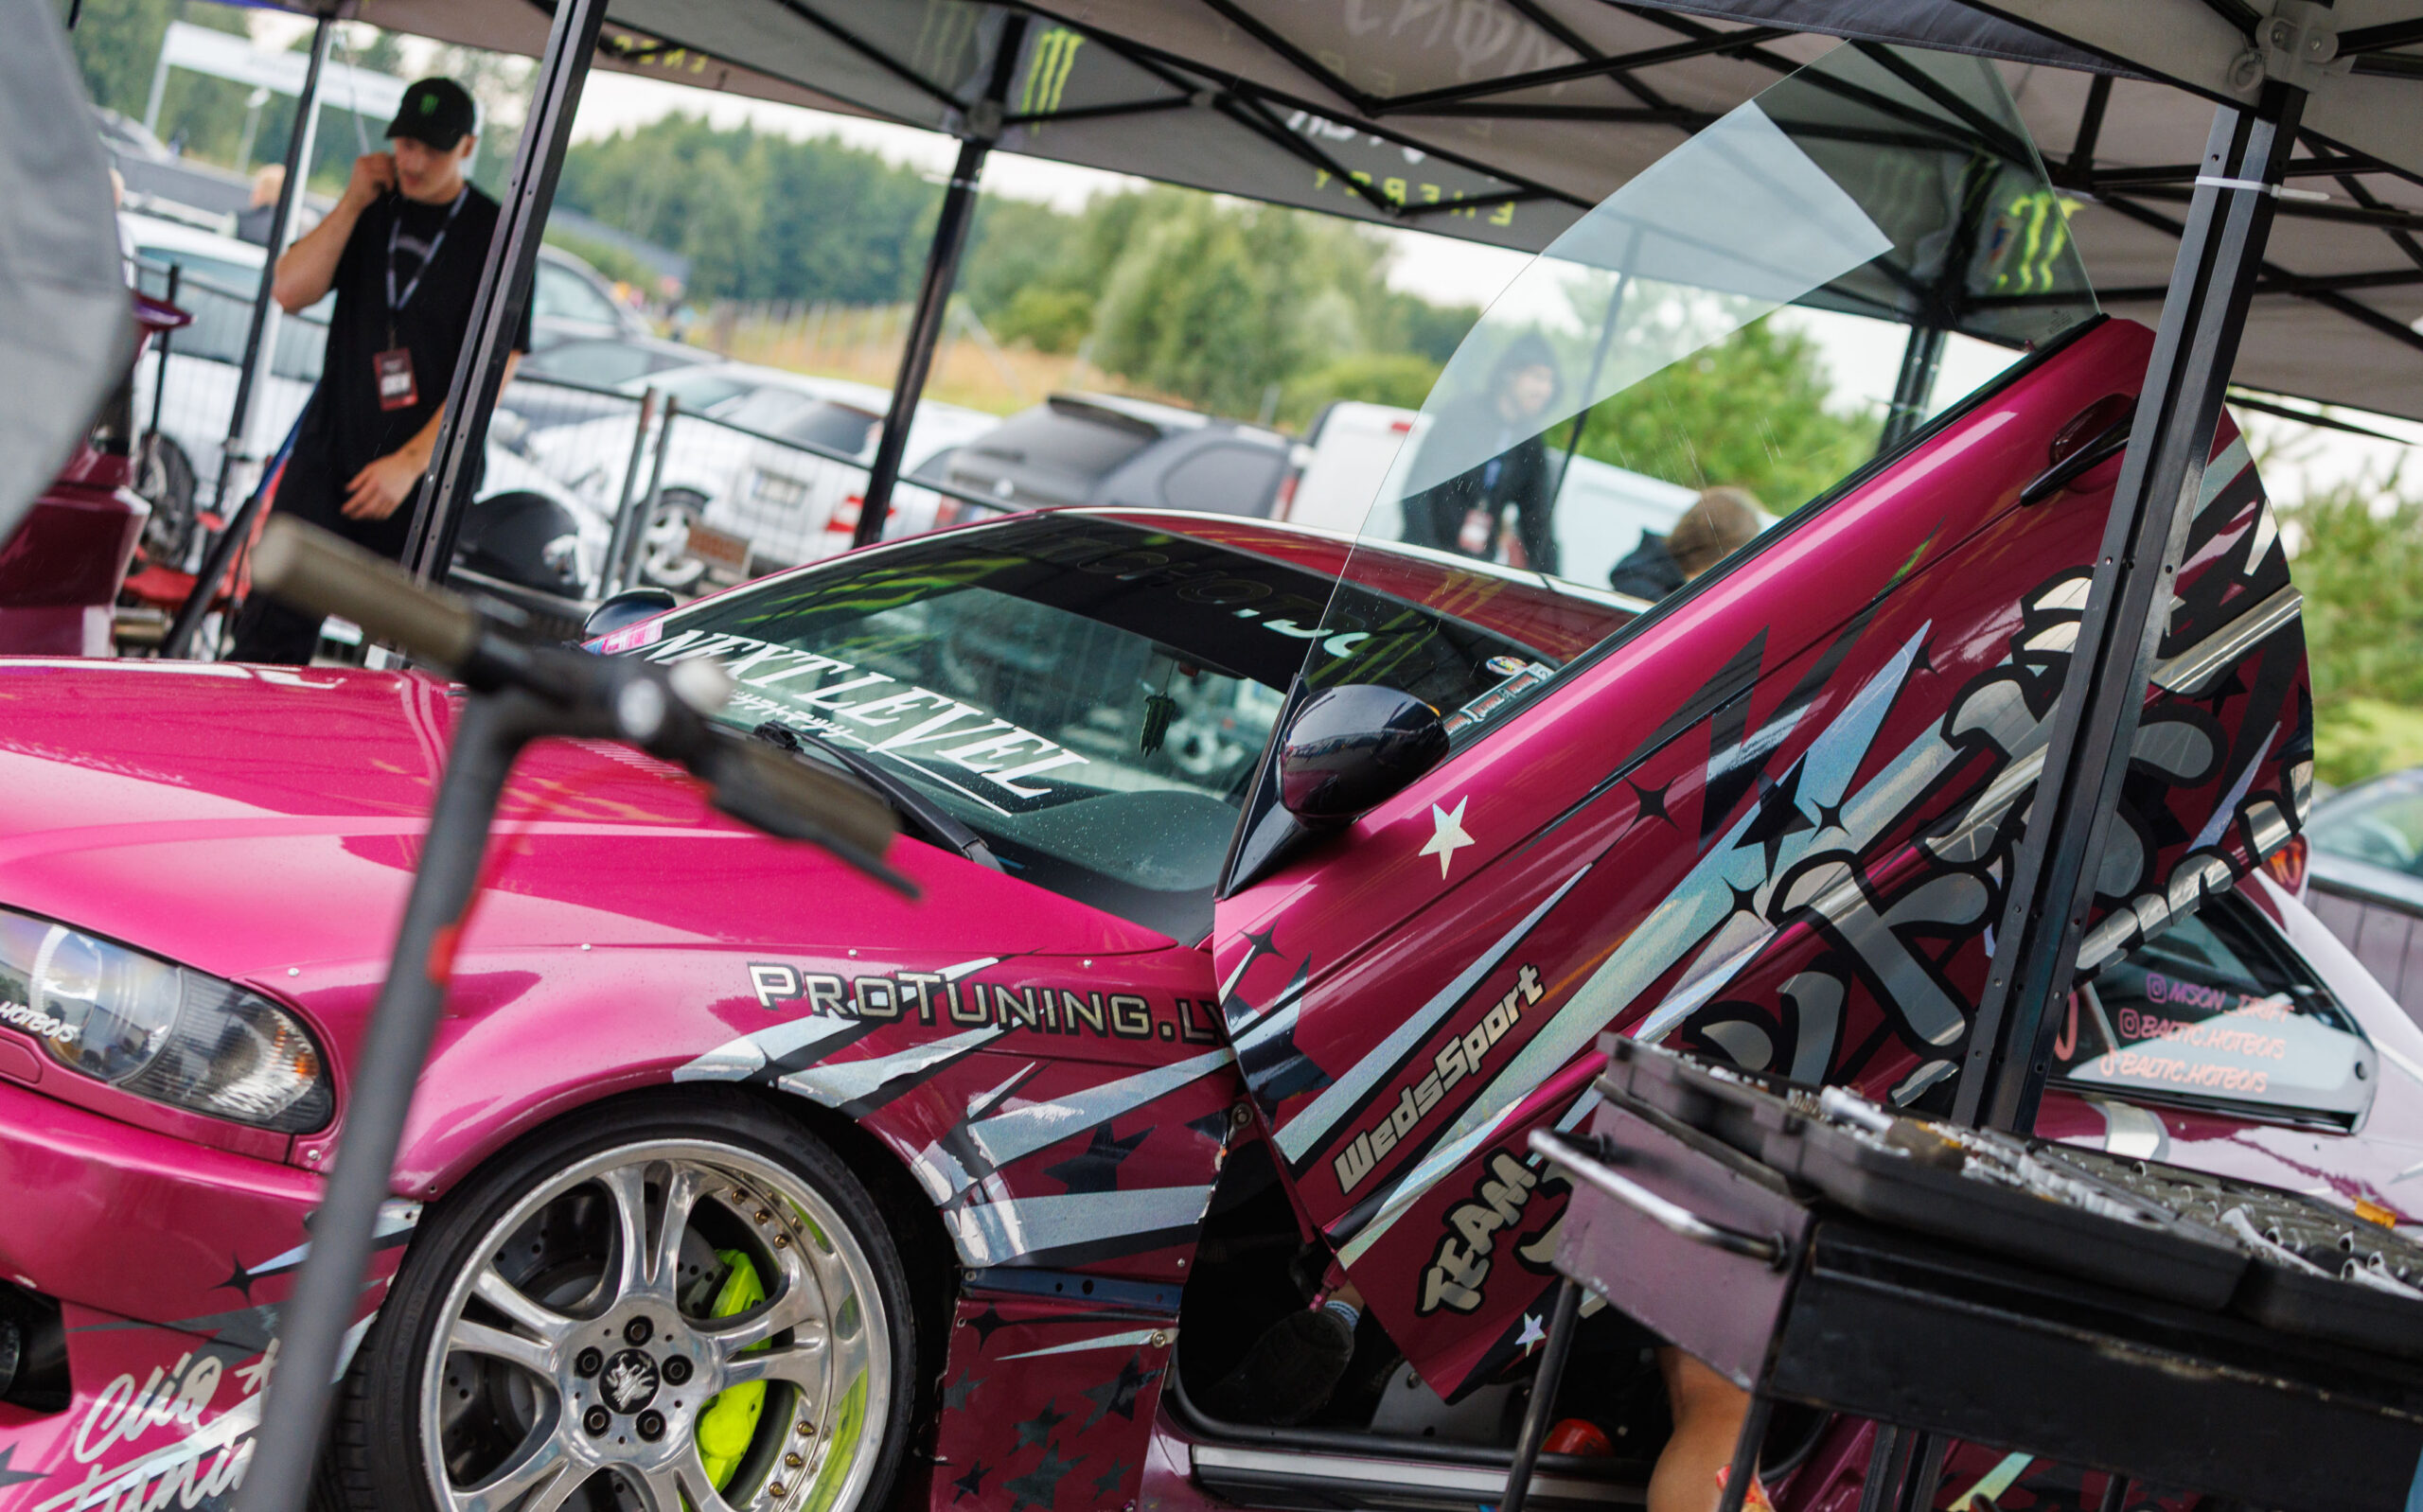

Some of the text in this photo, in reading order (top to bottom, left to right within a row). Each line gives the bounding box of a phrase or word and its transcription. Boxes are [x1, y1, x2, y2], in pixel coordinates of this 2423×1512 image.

[622, 629, 1090, 800] NEXT LEVEL
[1333, 963, 1545, 1195] WedsSport
[1417, 1148, 1538, 1315] TEAM
